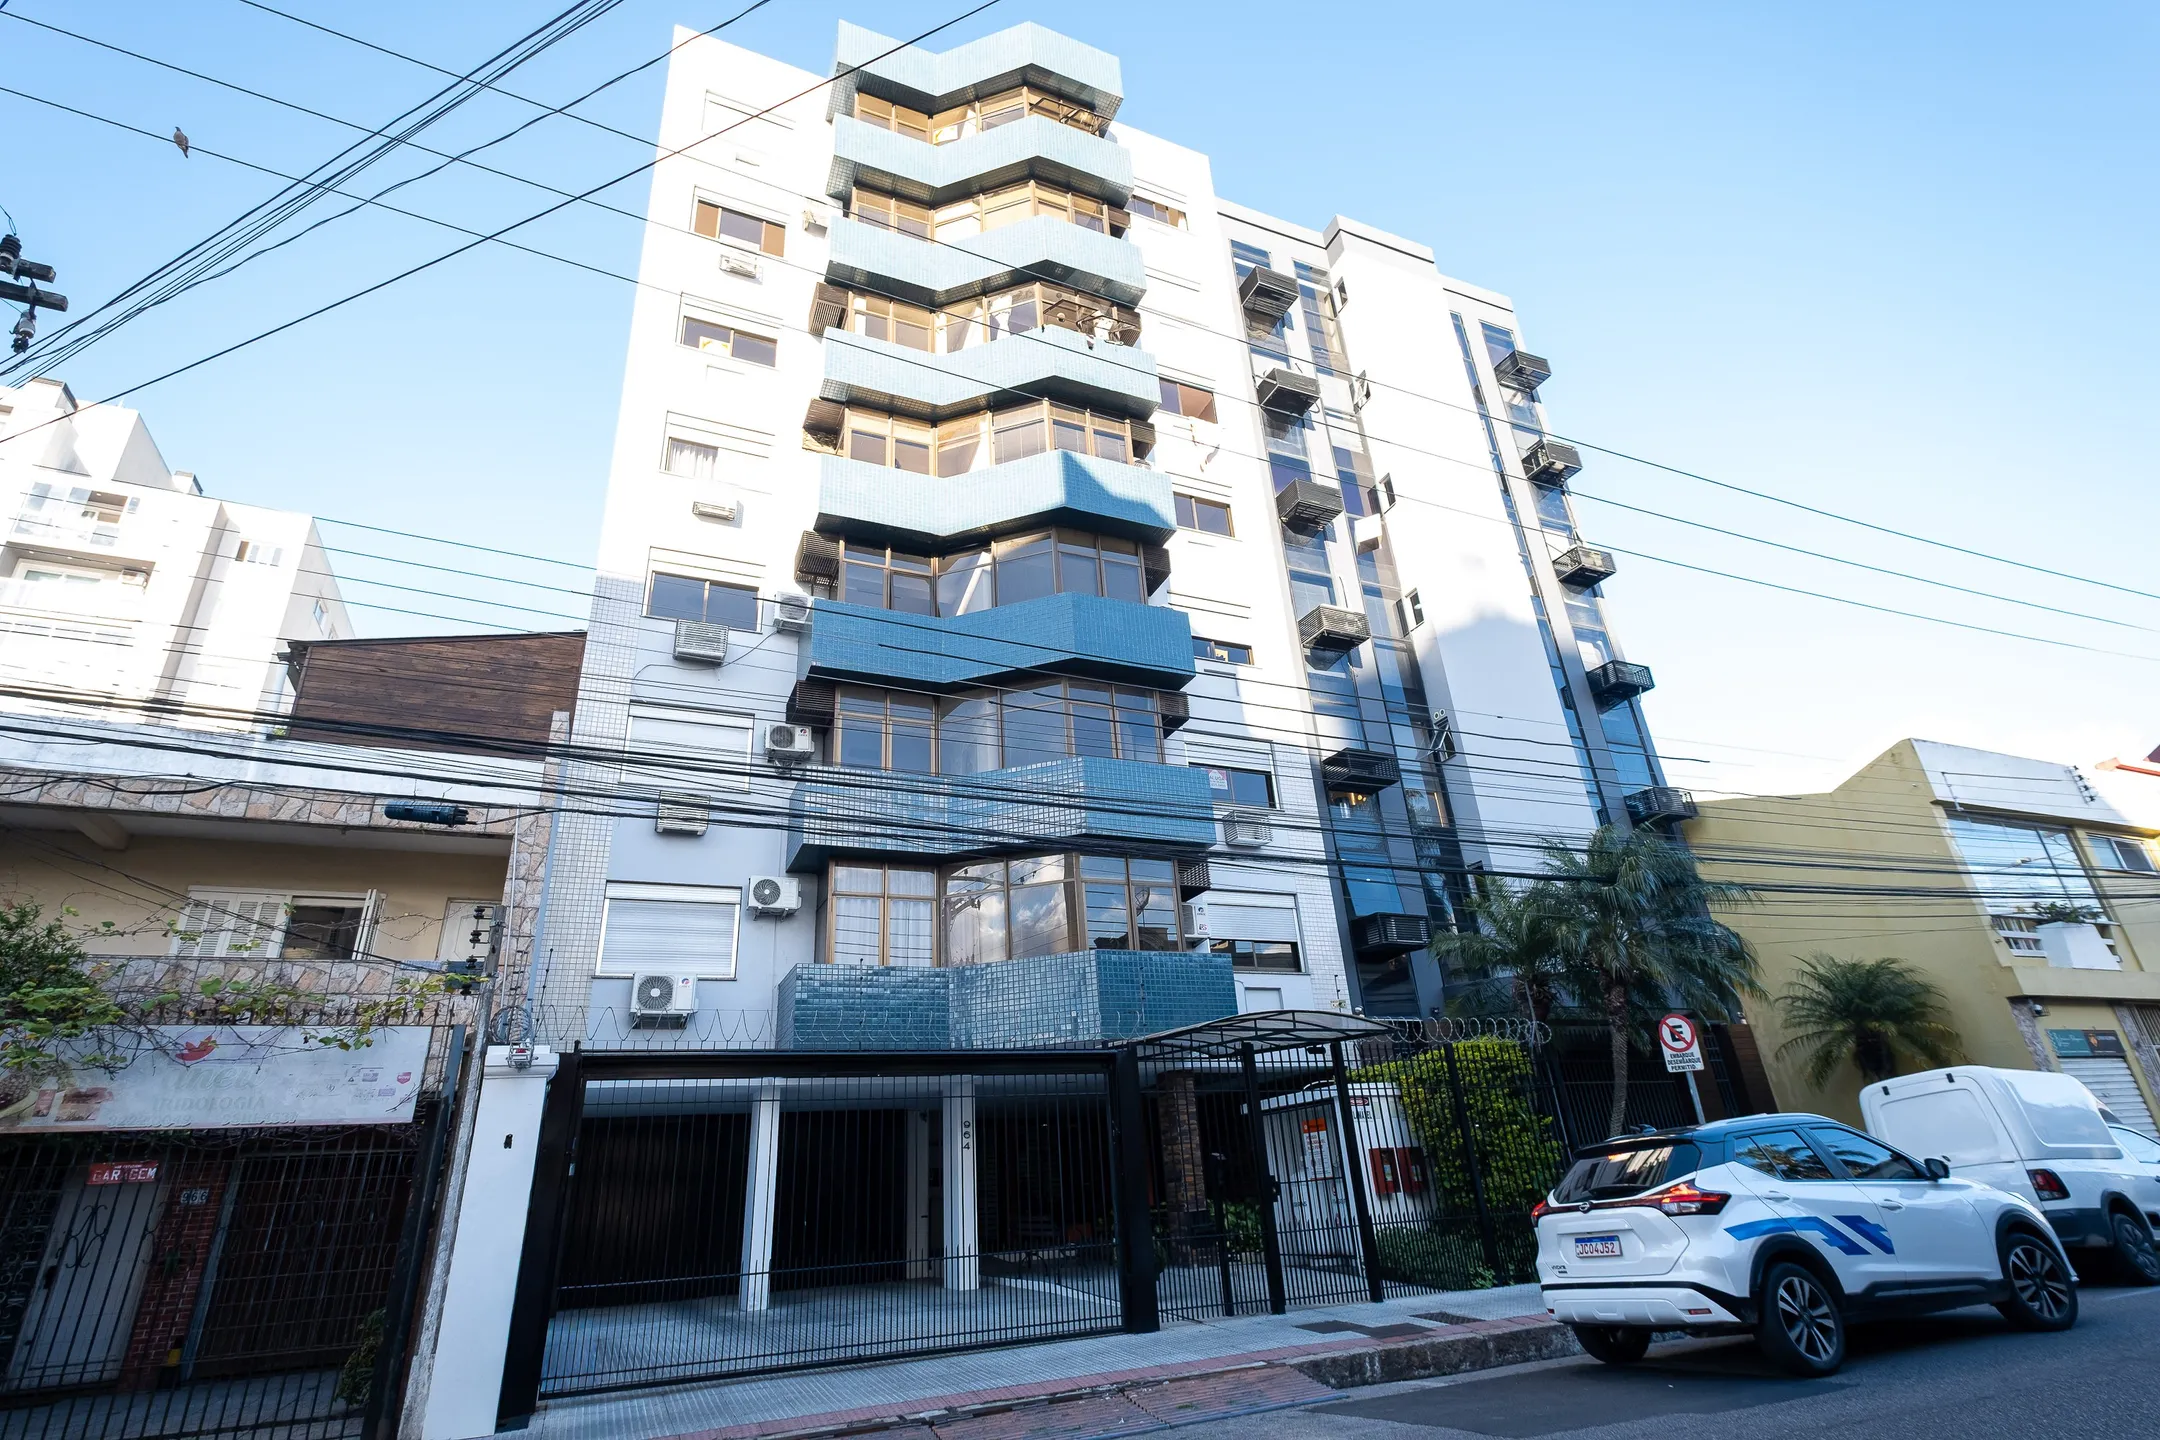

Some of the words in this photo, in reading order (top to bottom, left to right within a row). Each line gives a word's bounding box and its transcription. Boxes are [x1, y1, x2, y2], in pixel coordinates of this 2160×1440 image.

[1670, 1025, 1685, 1042] E
[1668, 1057, 1701, 1065] DESEMBARQUE
[962, 1120, 971, 1150] 964
[92, 1167, 158, 1182] GARGEM
[182, 1189, 209, 1204] 966
